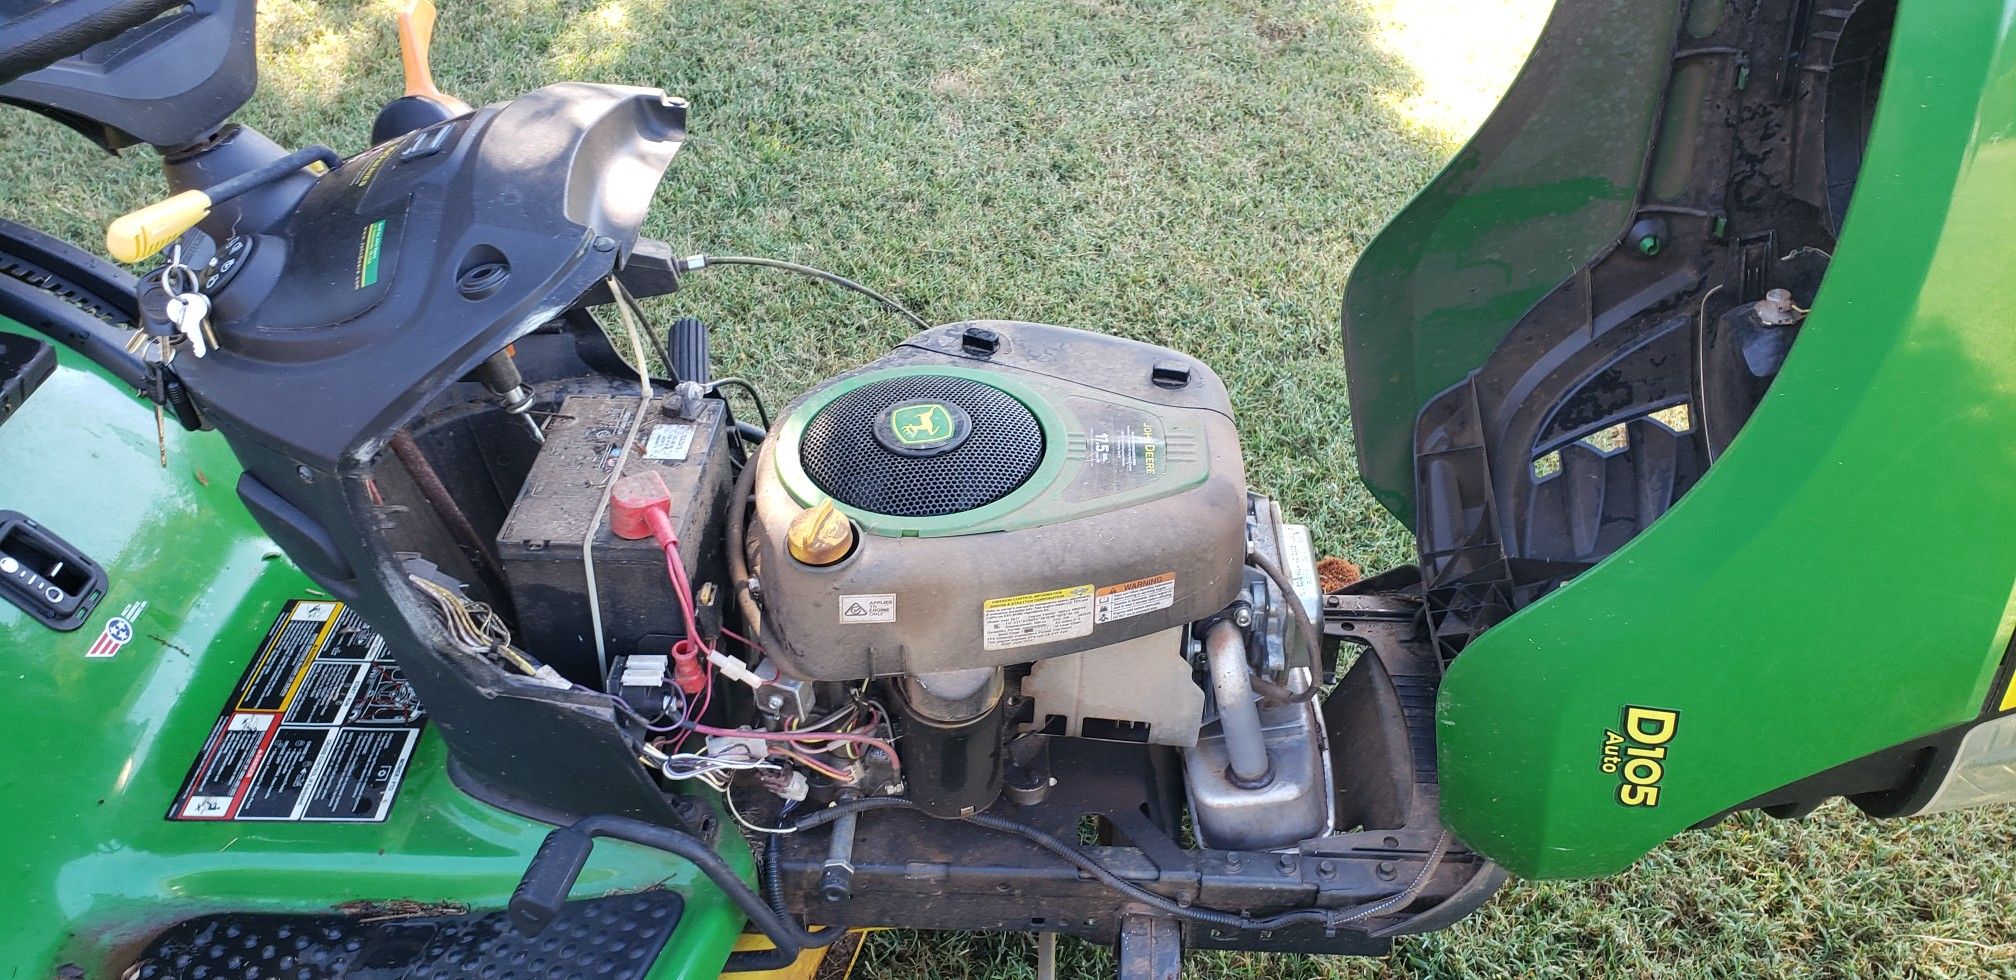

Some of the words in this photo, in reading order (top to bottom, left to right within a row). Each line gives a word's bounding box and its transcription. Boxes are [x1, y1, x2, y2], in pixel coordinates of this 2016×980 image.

[1095, 433, 1109, 452] 17.5
[1144, 444, 1156, 475] DEERE
[1124, 576, 1163, 591] WARNING
[1602, 731, 1625, 773] Auto
[1620, 707, 1677, 807] D105
